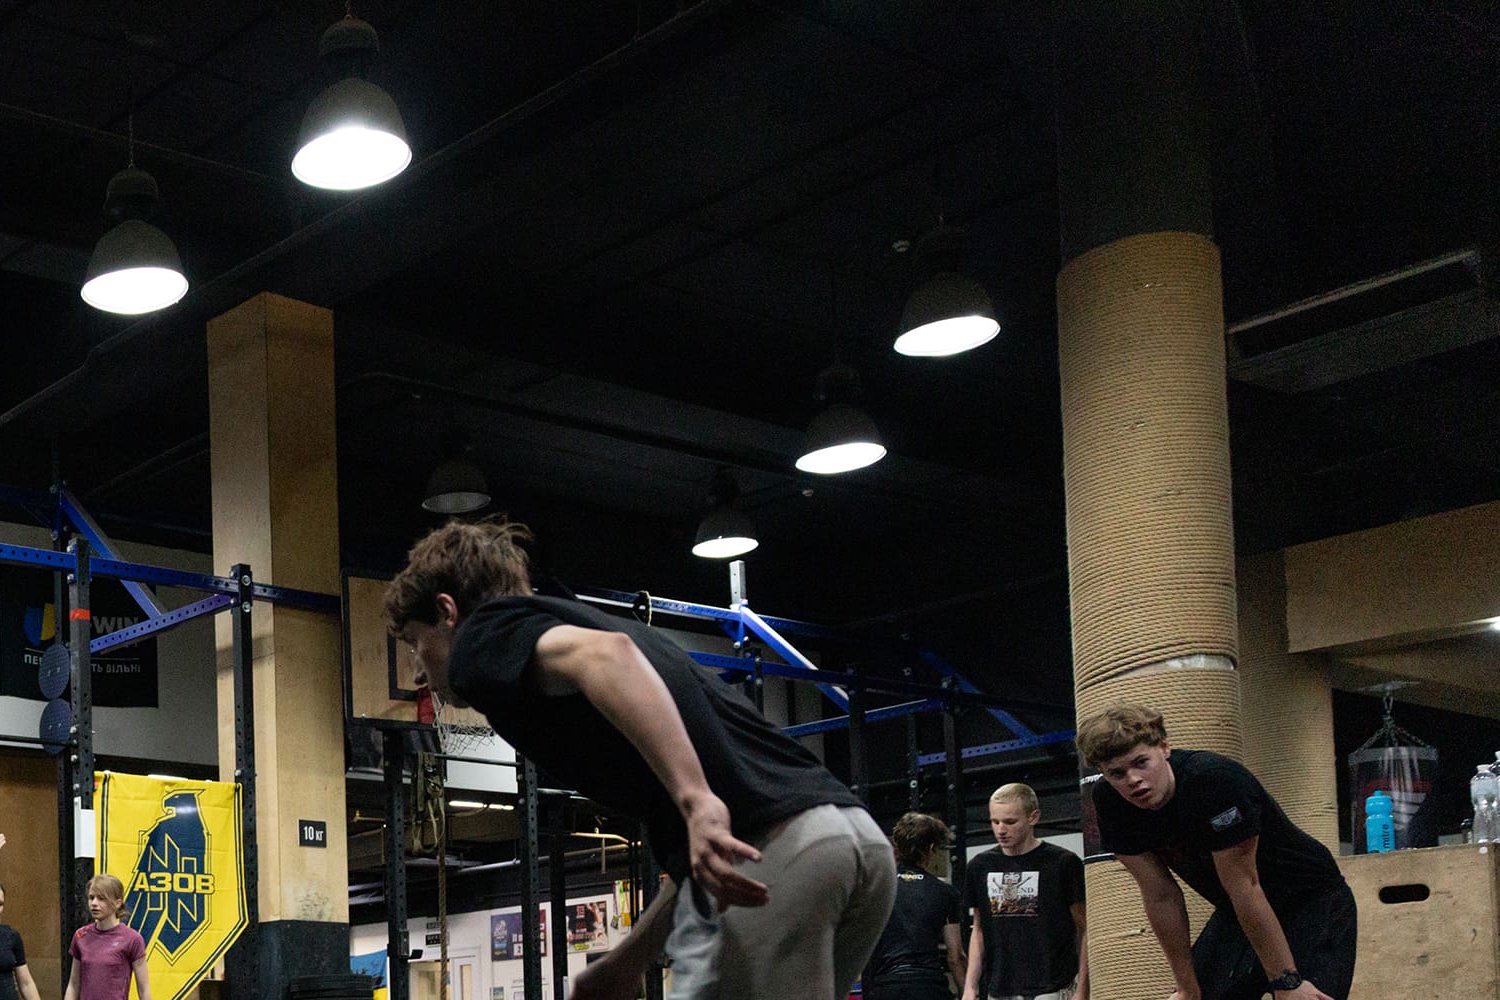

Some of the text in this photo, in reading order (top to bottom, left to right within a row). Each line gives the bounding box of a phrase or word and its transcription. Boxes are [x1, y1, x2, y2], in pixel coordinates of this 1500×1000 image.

[303, 825, 315, 841] 10
[1381, 823, 1390, 849] mitre
[133, 871, 215, 894] АЗОВ
